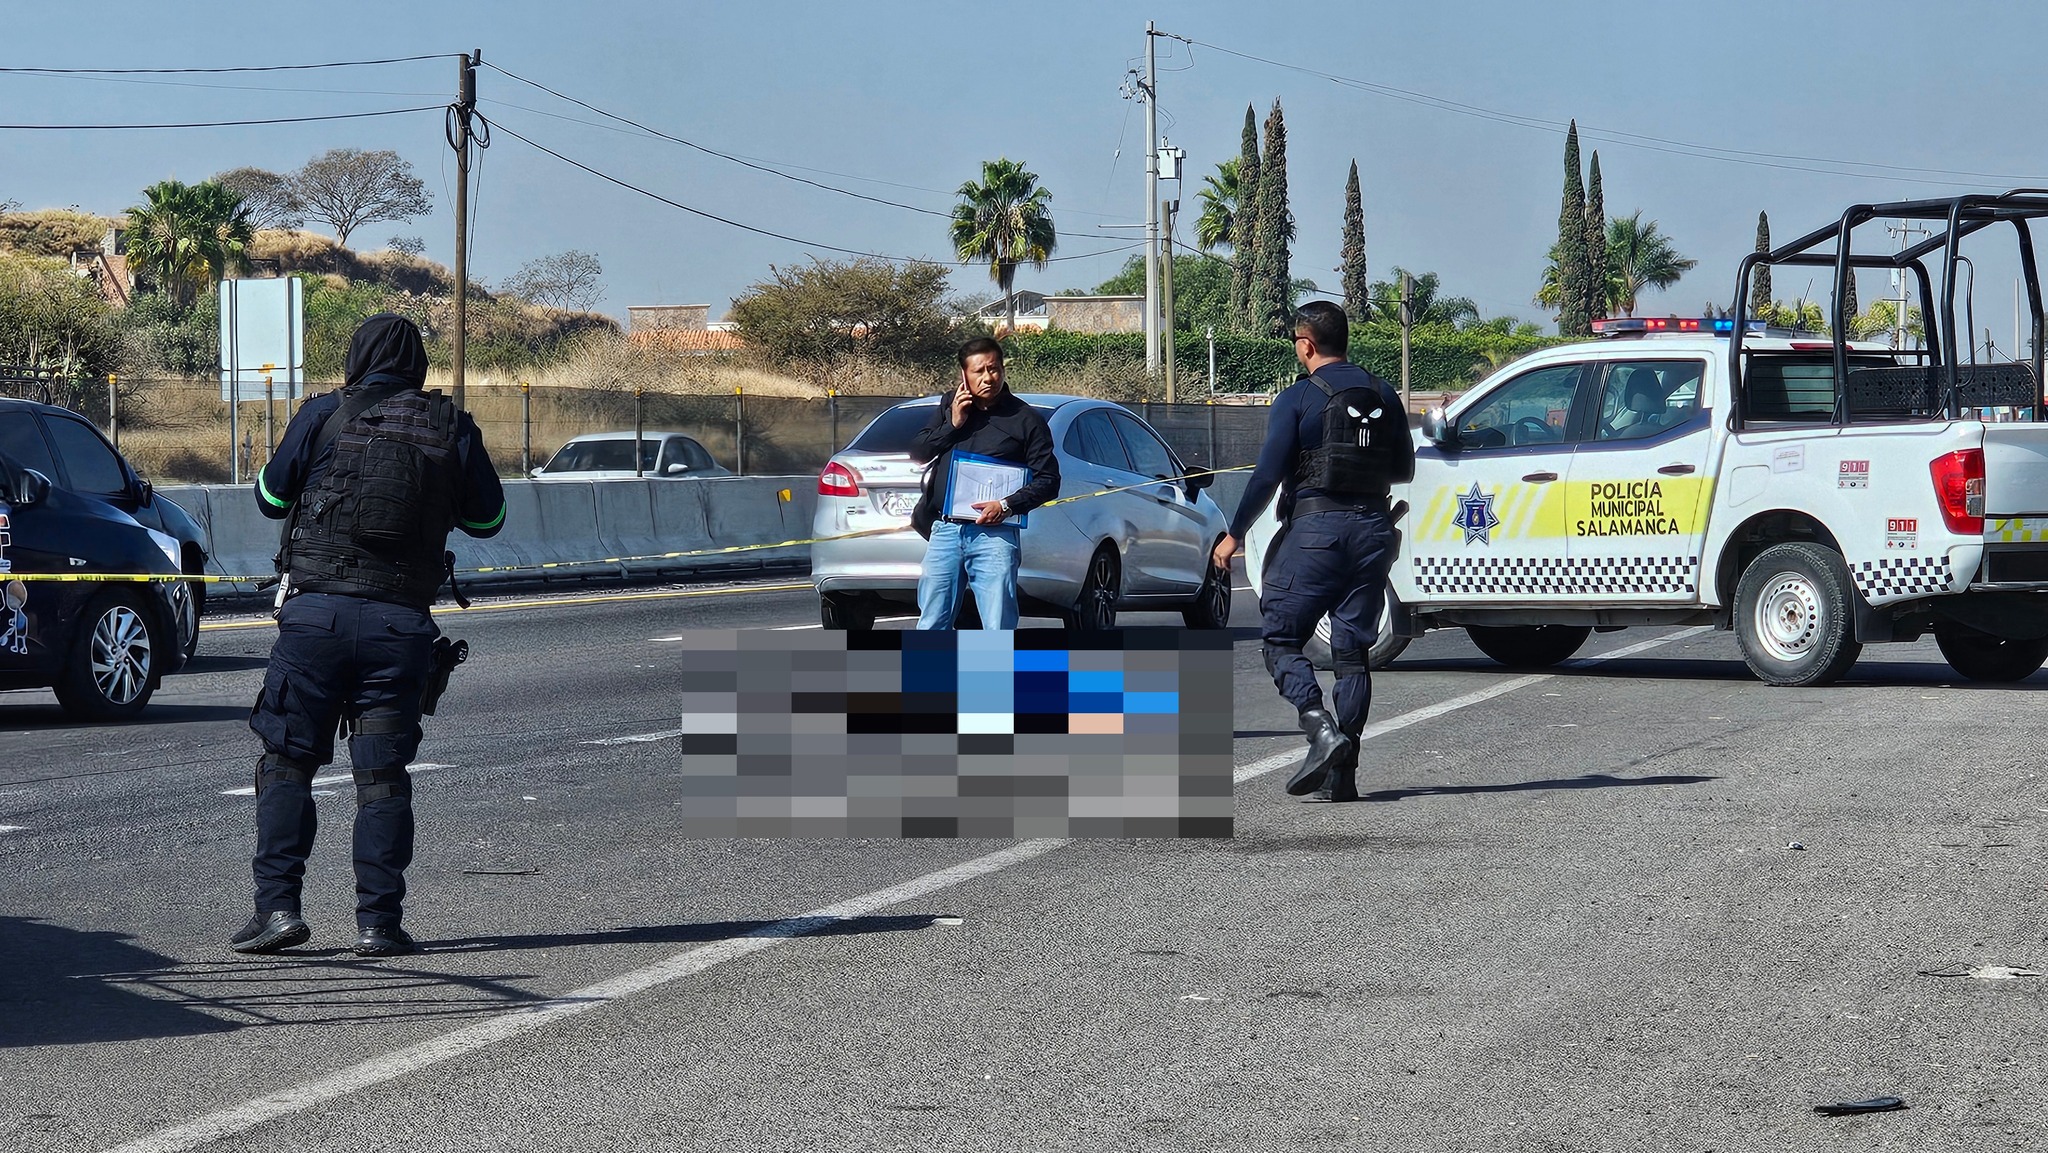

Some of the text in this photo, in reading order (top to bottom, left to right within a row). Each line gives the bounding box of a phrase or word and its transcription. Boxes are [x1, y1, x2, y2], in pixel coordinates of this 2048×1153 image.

[1840, 461, 1868, 472] 911
[1591, 478, 1662, 500] POLICÍA
[1591, 500, 1664, 518] MUNICIPAL
[1576, 518, 1680, 537] SALAMANCA
[1888, 520, 1916, 531] 911
